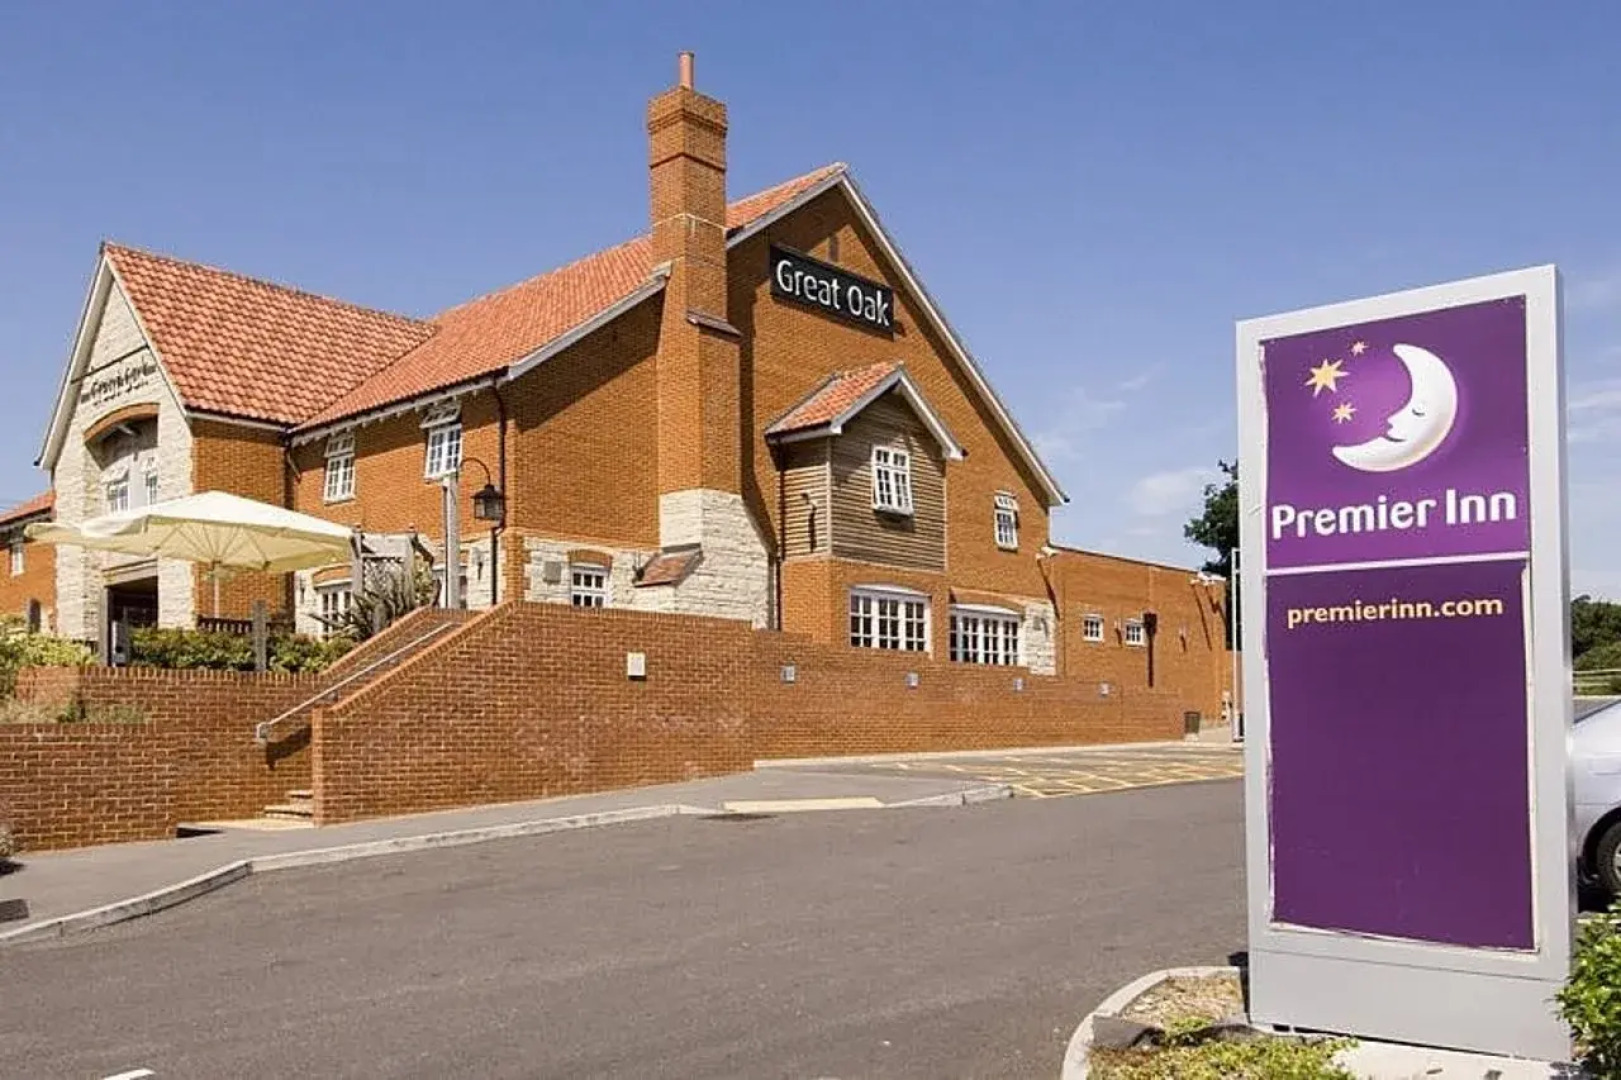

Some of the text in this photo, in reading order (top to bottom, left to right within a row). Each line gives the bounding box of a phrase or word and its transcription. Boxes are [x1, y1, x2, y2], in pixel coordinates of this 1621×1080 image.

[777, 260, 890, 327] Great Oak
[1272, 489, 1516, 539] Premier Inn
[1287, 598, 1503, 629] premierinn.com
